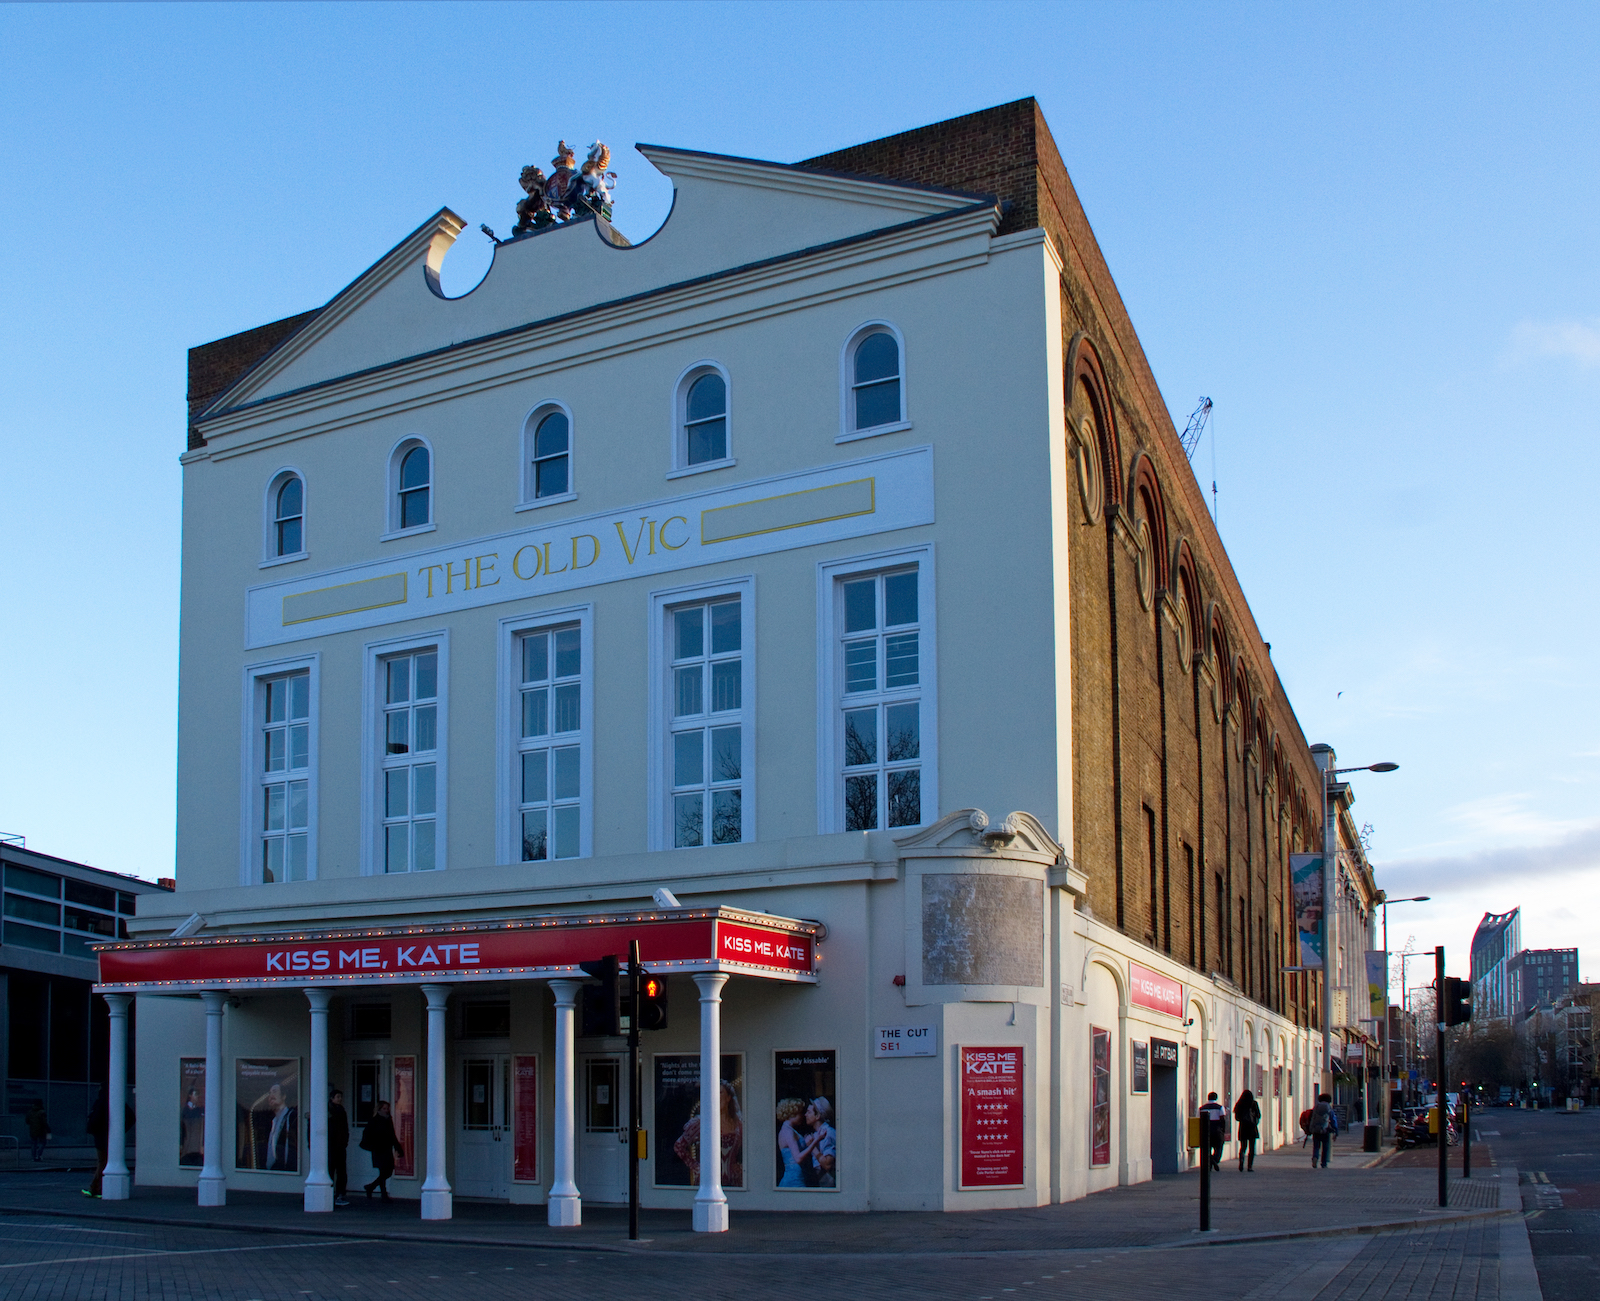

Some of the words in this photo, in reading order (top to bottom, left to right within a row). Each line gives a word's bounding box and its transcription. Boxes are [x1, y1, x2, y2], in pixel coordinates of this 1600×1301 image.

[418, 553, 501, 598] THE
[512, 534, 600, 580] OLD
[614, 516, 690, 565] VIC
[724, 936, 752, 952] KISS
[754, 941, 774, 957] ME,
[776, 944, 804, 960] KATE
[266, 950, 330, 971] KISS
[339, 948, 388, 970] ME,
[398, 943, 480, 966] KATE
[1140, 979, 1153, 996] KISS
[1162, 988, 1174, 1004] KATE
[881, 1030, 900, 1038] THE
[908, 1028, 928, 1038] CUT
[880, 1042, 900, 1050] SE1
[966, 1052, 996, 1061] KISS
[966, 1062, 1016, 1074] KATE
[977, 1088, 1001, 1096] smash
